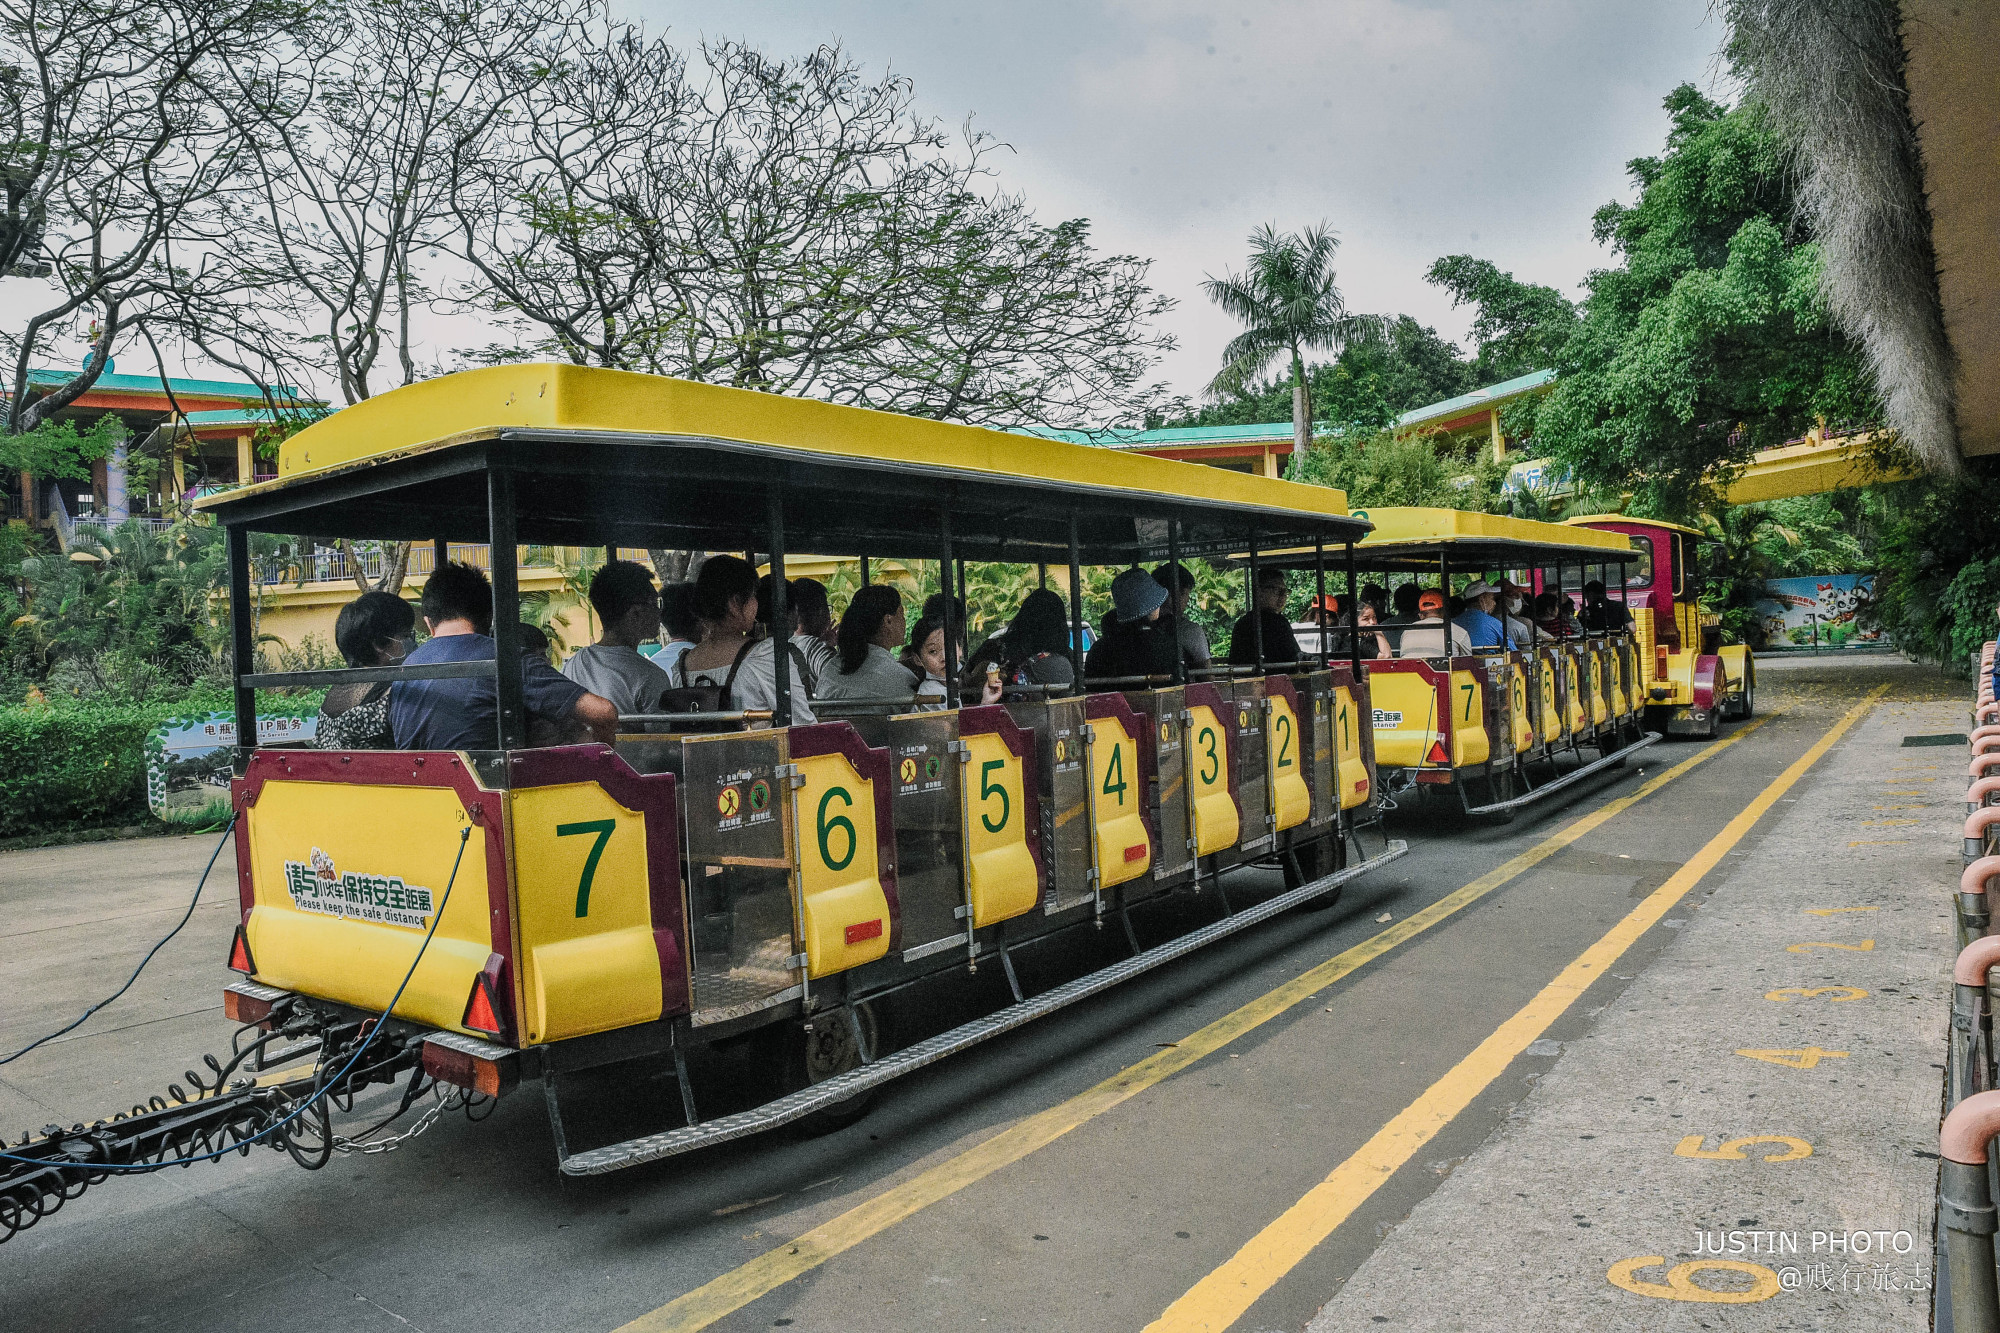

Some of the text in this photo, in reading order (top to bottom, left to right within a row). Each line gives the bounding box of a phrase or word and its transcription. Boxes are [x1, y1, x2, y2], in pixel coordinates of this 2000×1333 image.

[1544, 671, 1552, 703] 5
[1569, 669, 1576, 697] 4
[1593, 662, 1599, 690] 3
[1460, 684, 1475, 721] 7
[1514, 677, 1522, 712] 6
[204, 719, 302, 736] 电瓶IP服务
[1276, 715, 1292, 768] 2
[1338, 705, 1348, 751] 1
[1199, 727, 1218, 785] 3
[1103, 742, 1127, 806] 4
[981, 759, 1010, 833] 5
[817, 786, 857, 871] 6
[556, 818, 616, 918] 7
[286, 863, 432, 912] 请与小火车保持安全距离
[295, 896, 425, 926] Please keep the safe distance
[1803, 906, 1881, 917] 1
[1786, 939, 1876, 953] 2
[1764, 986, 1869, 1002] 3
[1735, 1046, 1851, 1069] 4
[1673, 1135, 1813, 1163] 5
[1606, 1256, 1783, 1304] 6
